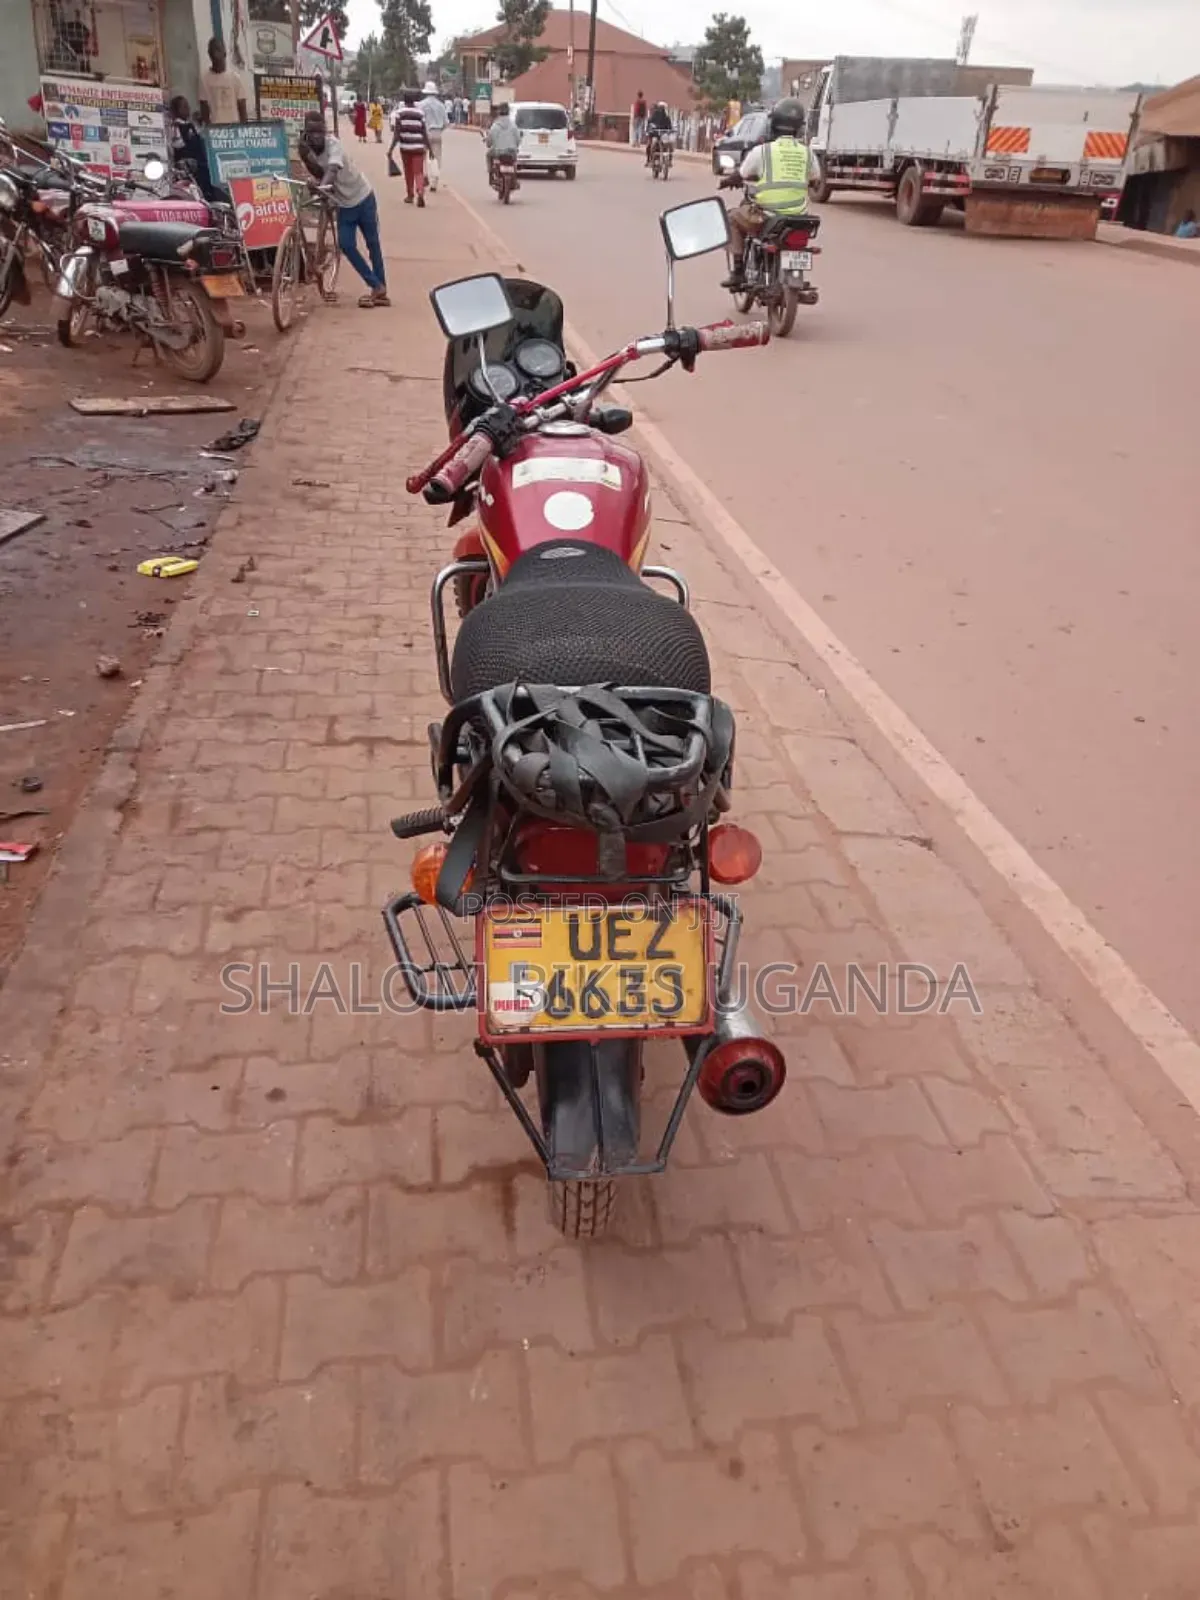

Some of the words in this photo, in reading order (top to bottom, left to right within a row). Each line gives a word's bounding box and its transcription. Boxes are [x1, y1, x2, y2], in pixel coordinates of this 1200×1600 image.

[238, 127, 272, 138] MERCY
[256, 200, 290, 216] airtel
[568, 910, 676, 961] UEZ
